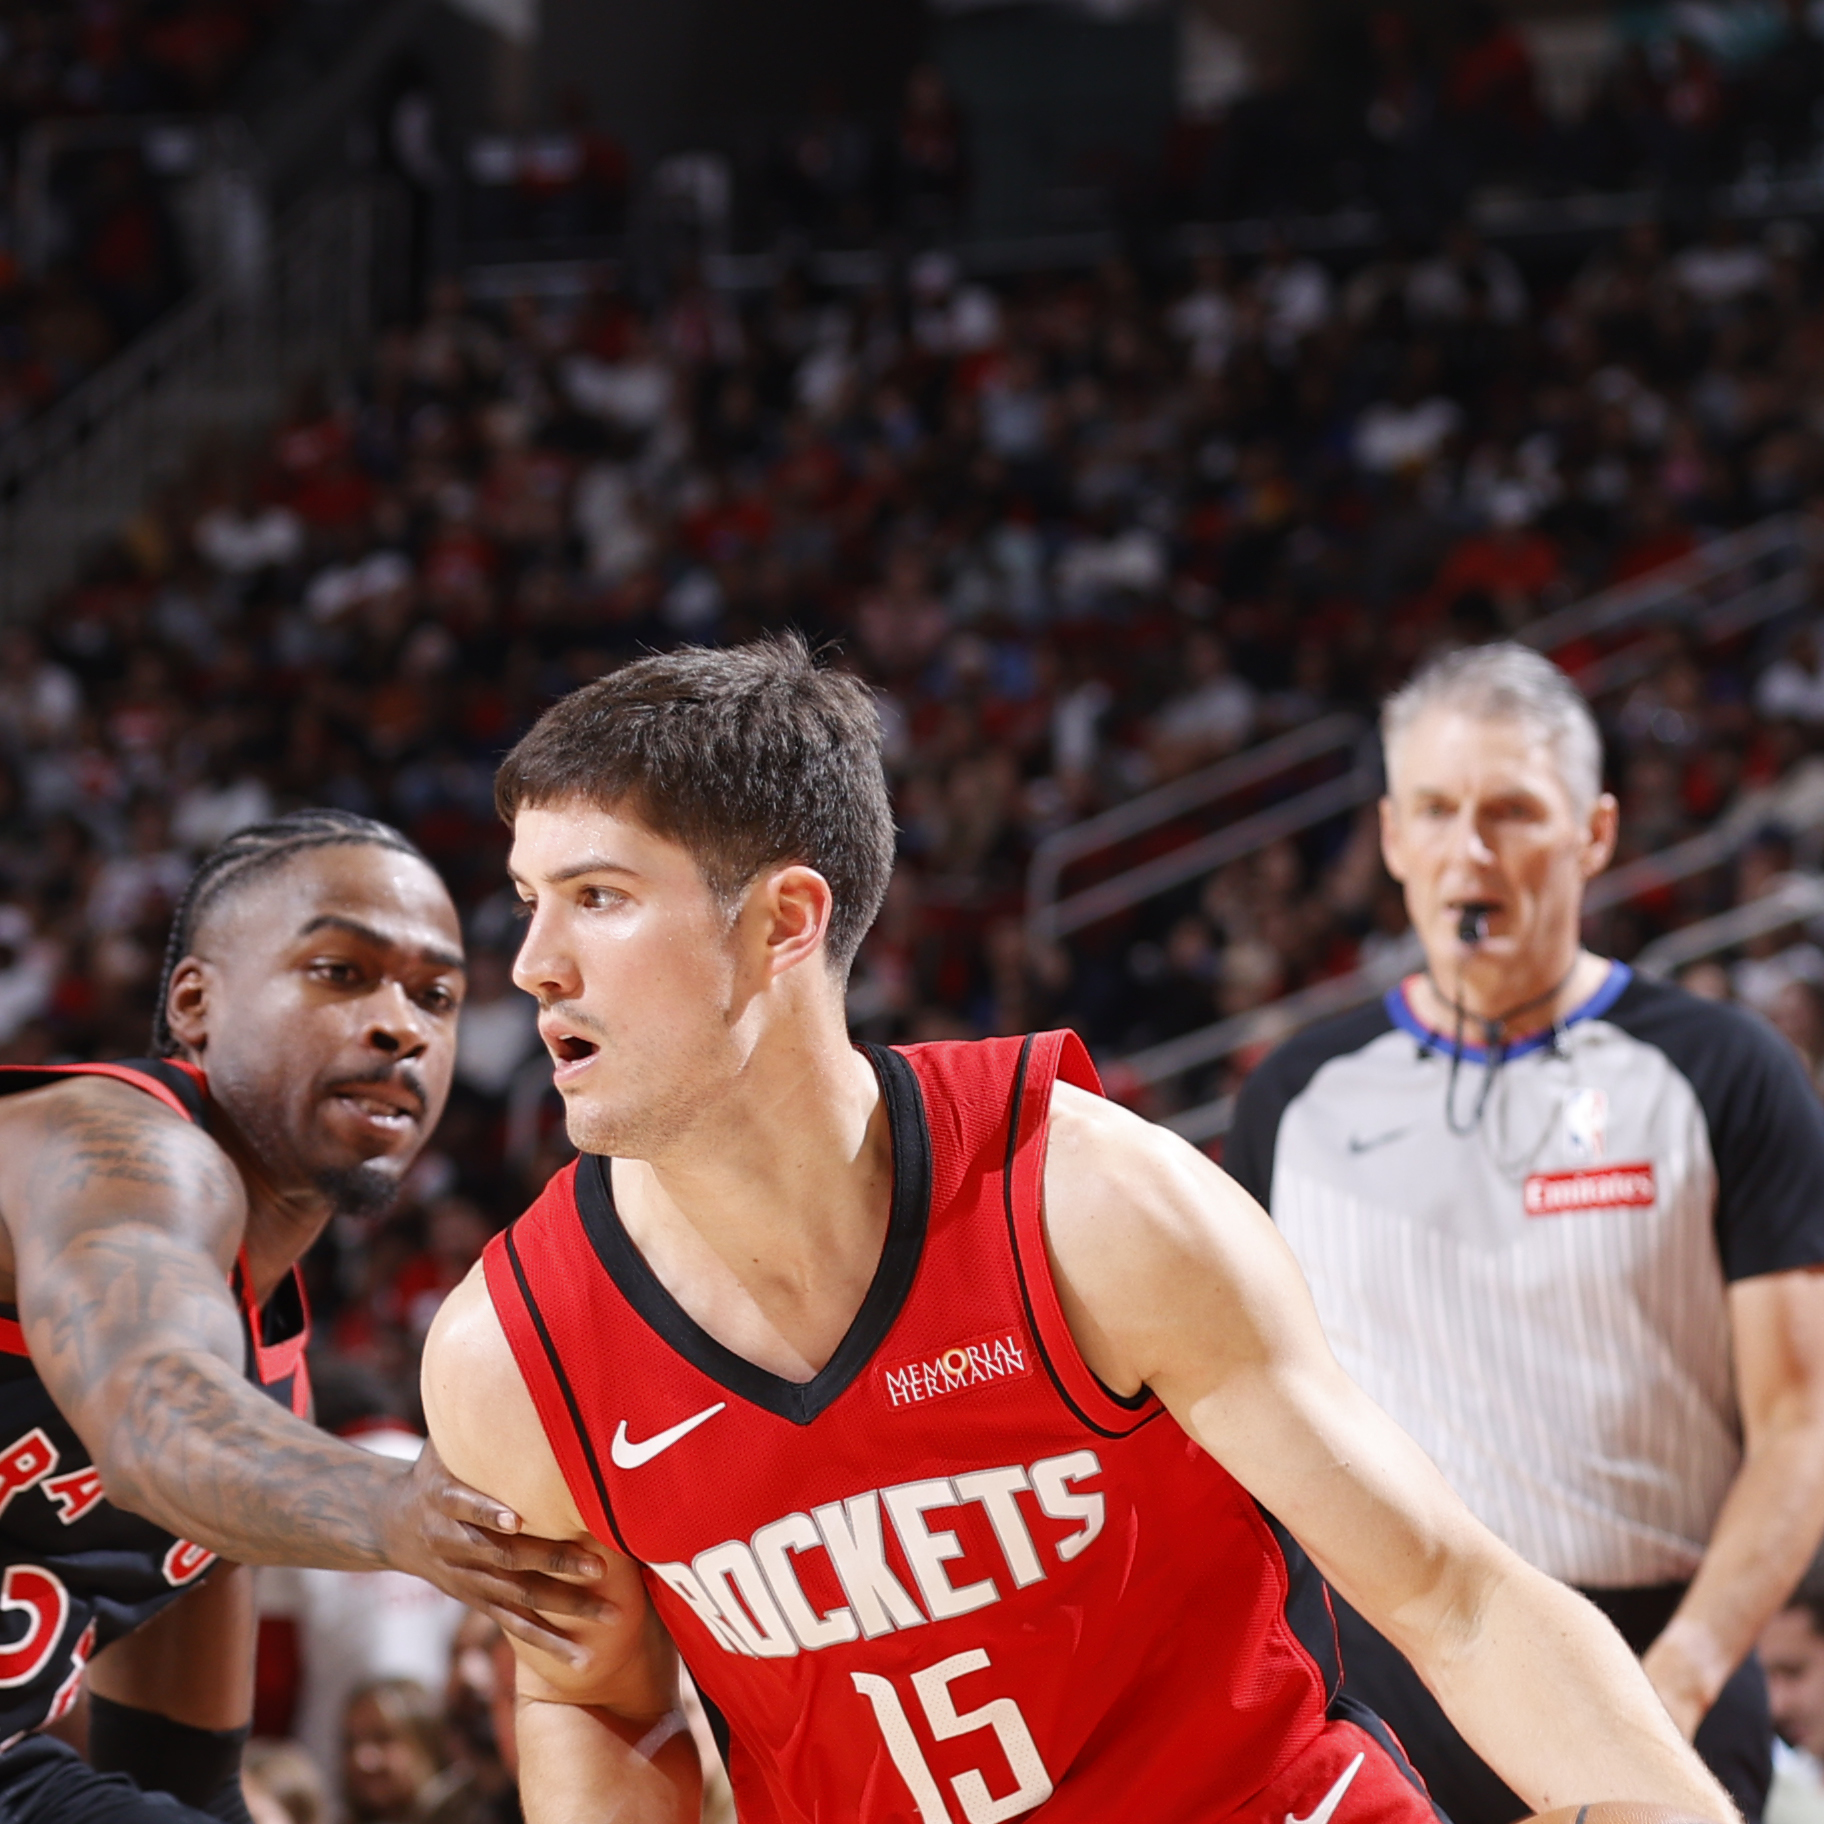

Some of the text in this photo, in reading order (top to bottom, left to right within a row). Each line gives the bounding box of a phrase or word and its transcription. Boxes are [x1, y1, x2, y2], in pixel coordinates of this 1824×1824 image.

[885, 1336, 1023, 1389] MEMORIAL
[888, 1352, 1025, 1406] HERMANN
[644, 1449, 1105, 1658] ROCKETS
